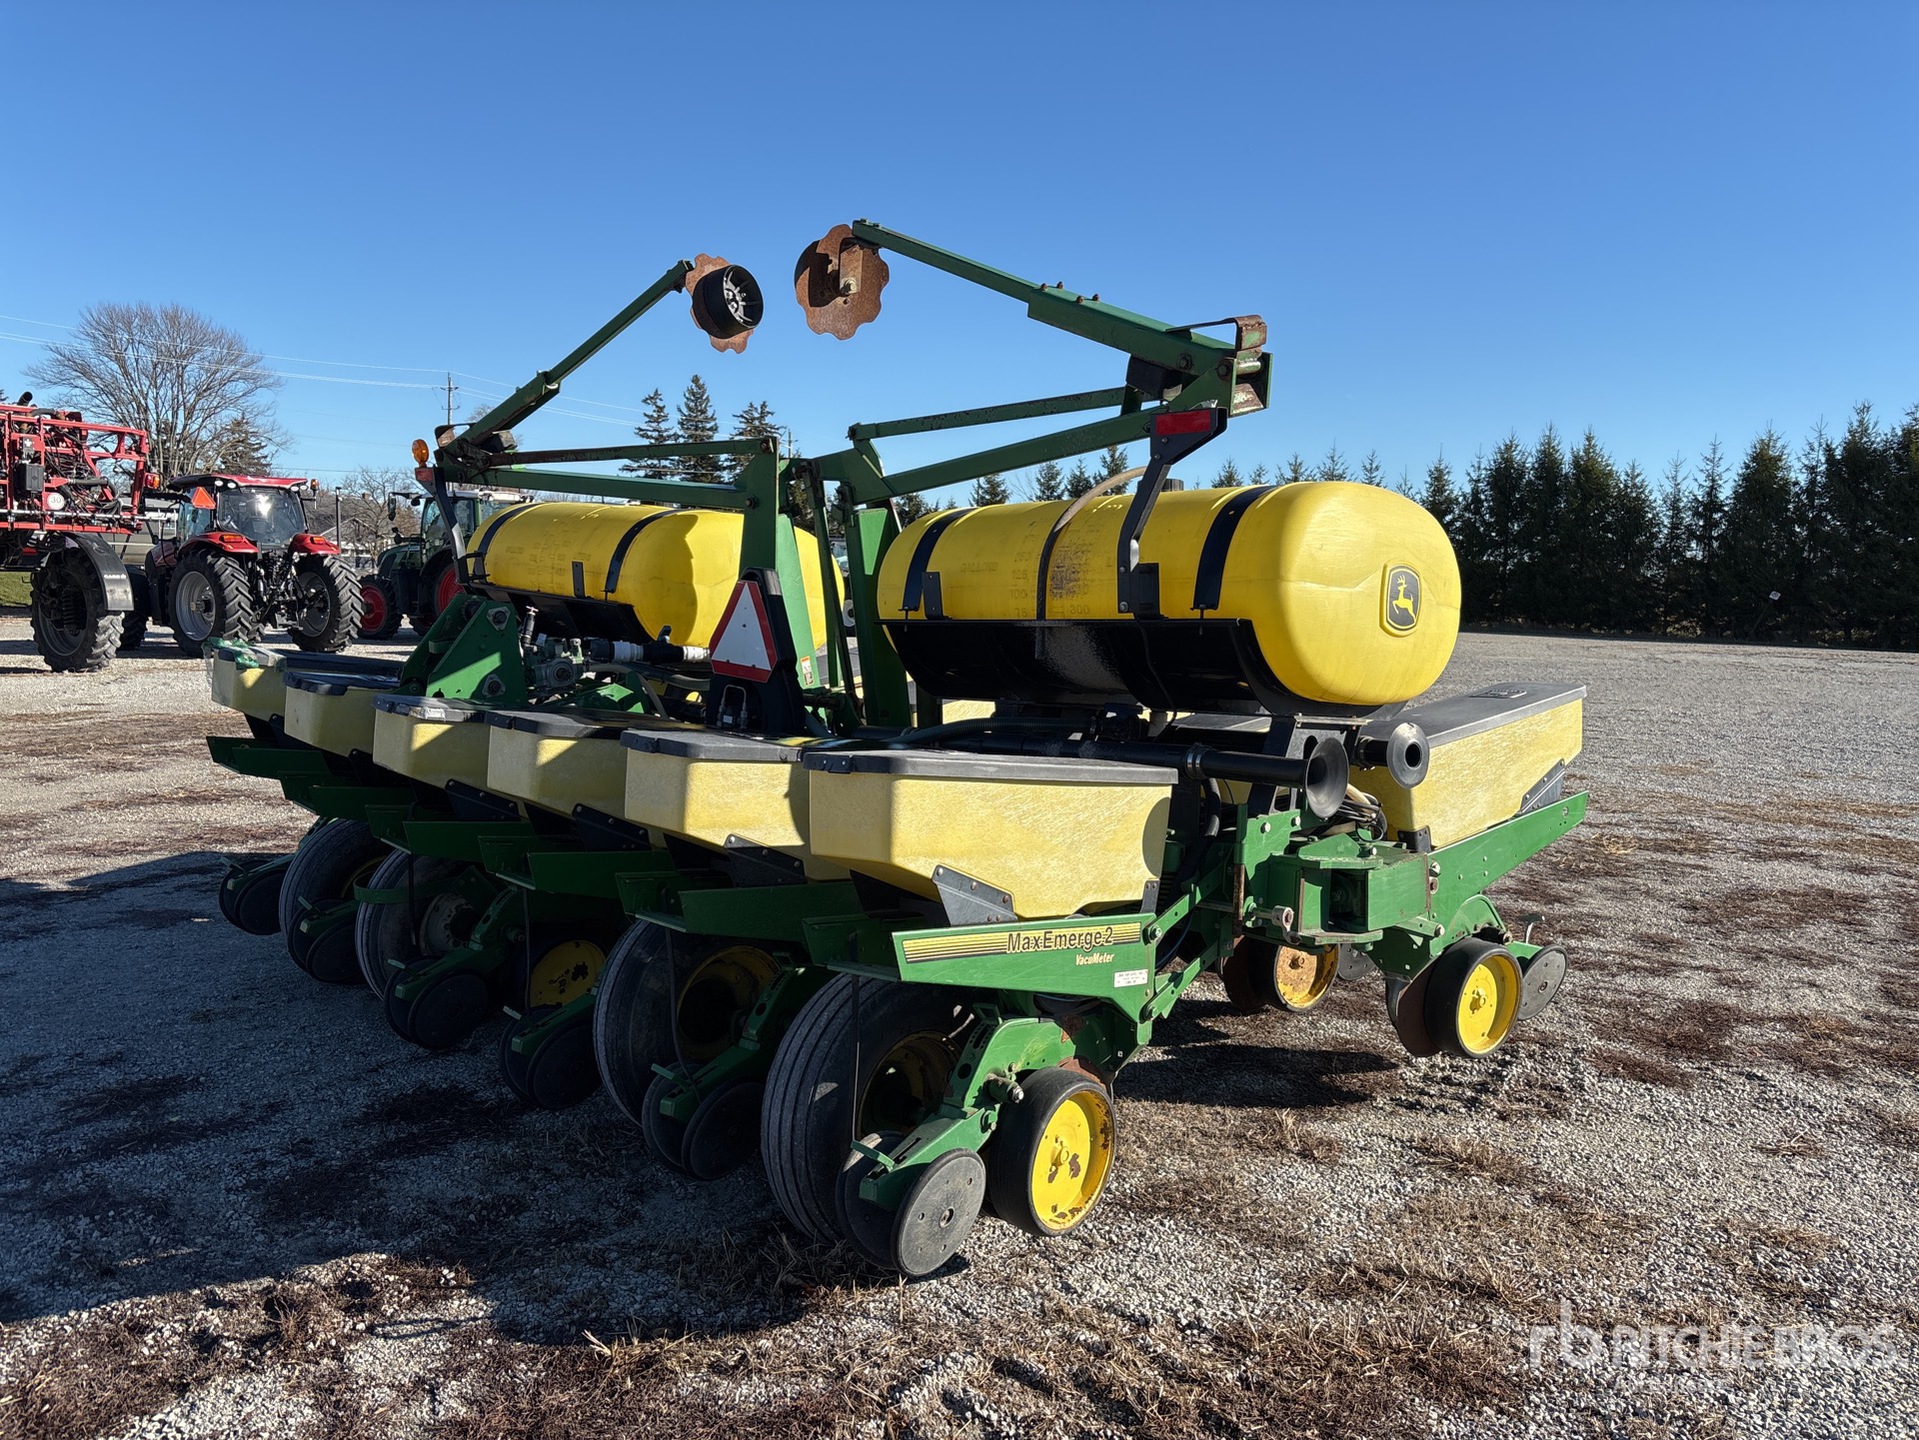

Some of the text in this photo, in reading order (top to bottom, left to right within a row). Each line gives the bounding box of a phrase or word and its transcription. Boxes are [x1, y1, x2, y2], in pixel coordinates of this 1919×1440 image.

[50, 496, 62, 504] 30
[1007, 926, 1114, 951] MaxEmerge 2
[1075, 952, 1115, 966] VacuMeter
